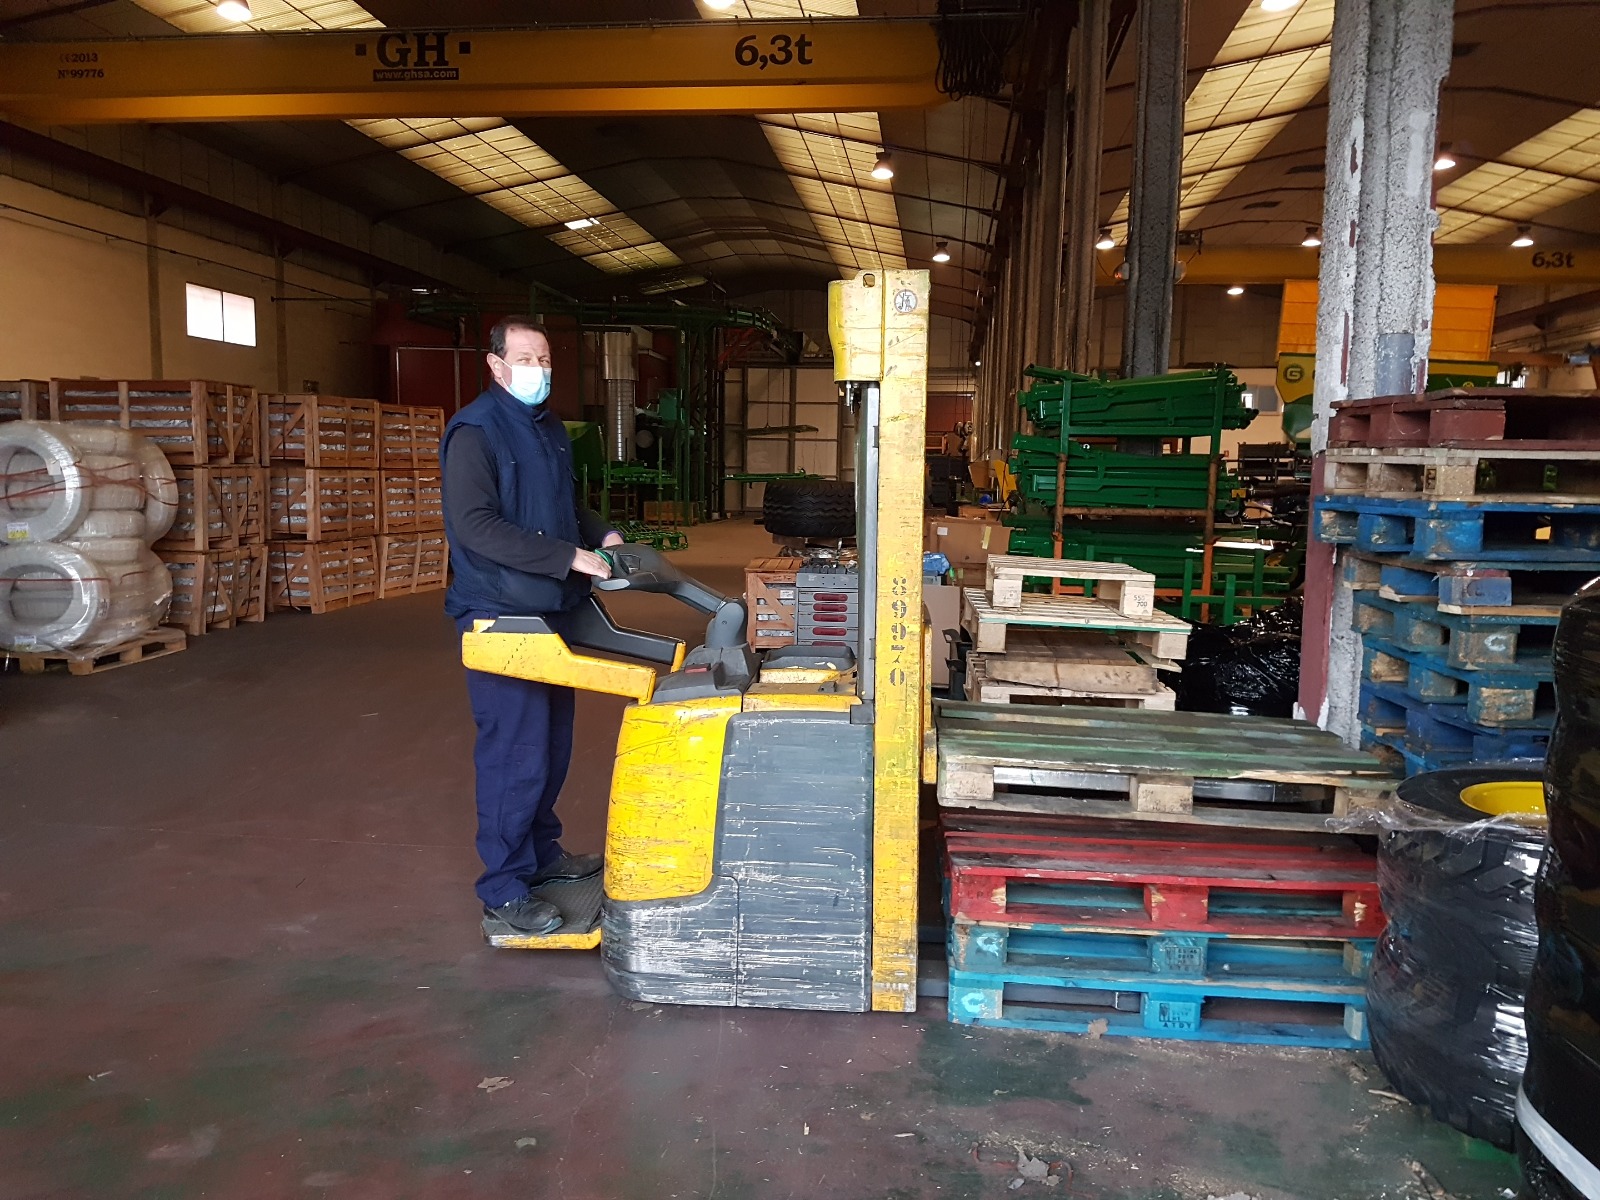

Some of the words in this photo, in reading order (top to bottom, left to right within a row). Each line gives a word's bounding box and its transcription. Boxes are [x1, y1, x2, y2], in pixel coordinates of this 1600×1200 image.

[71, 53, 98, 62] 2013
[376, 31, 449, 68] GH
[735, 34, 813, 70] 6,3t
[375, 69, 457, 80] www.ghsa.com
[1532, 251, 1575, 269] 6,3t
